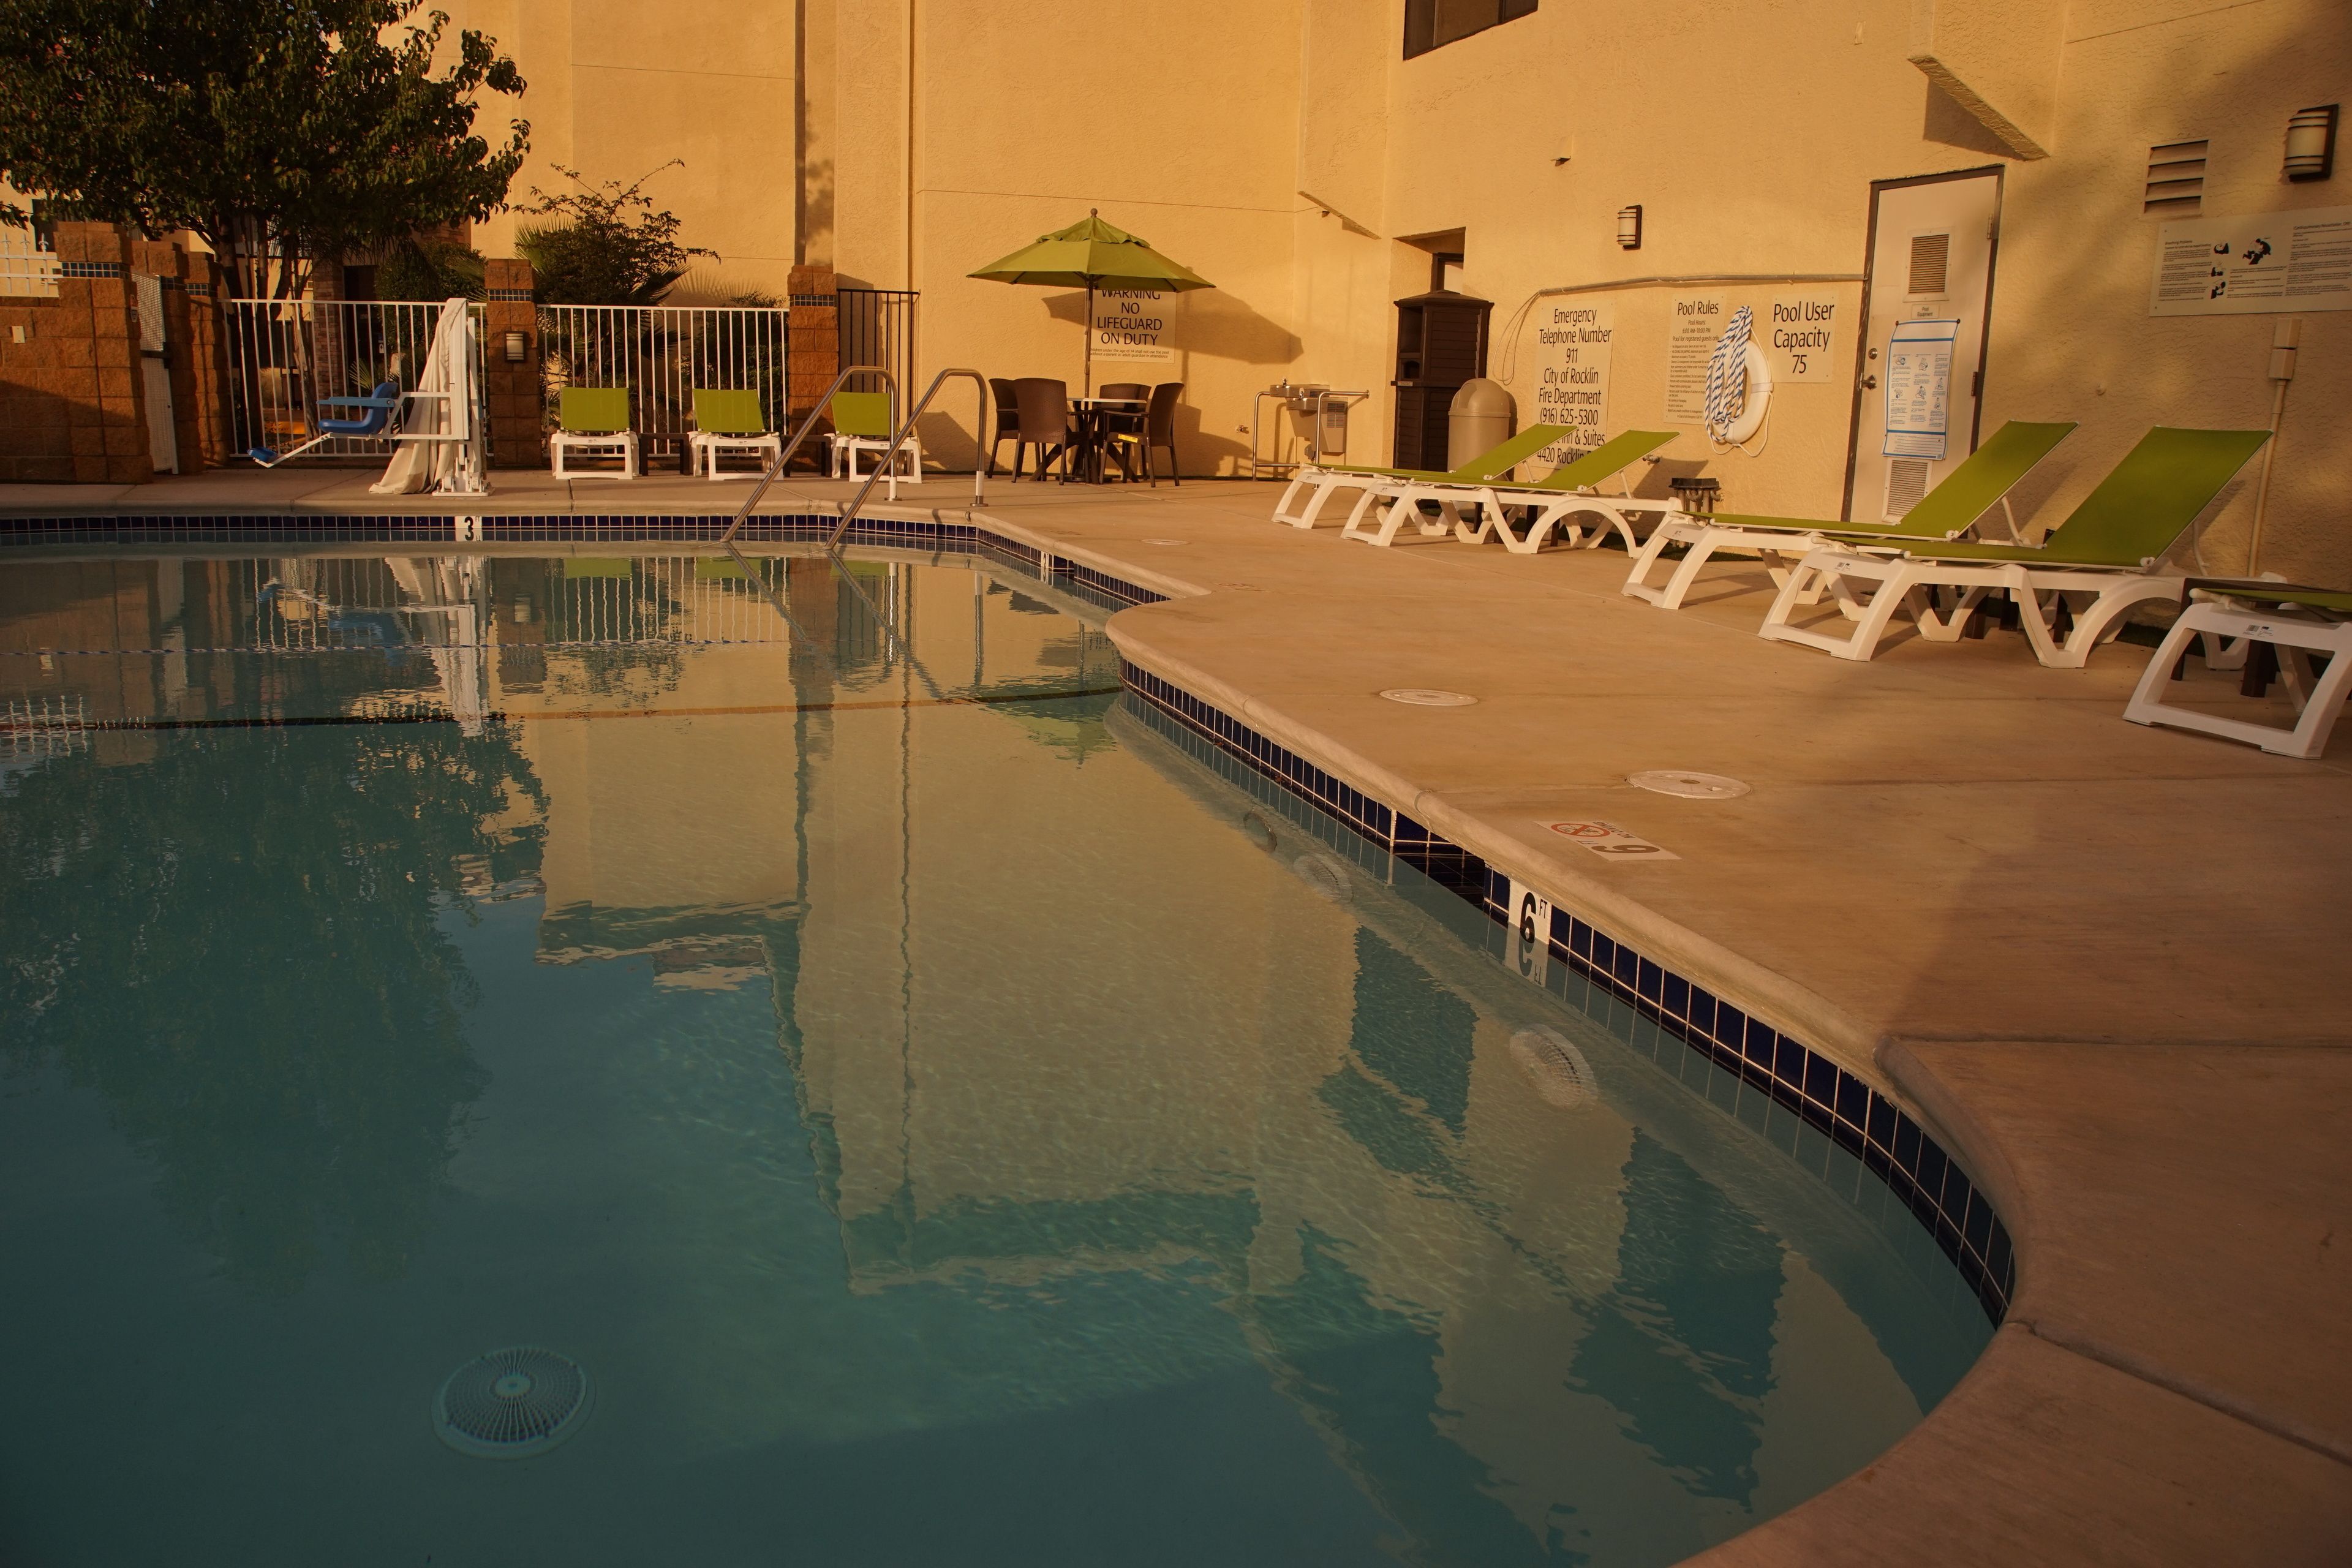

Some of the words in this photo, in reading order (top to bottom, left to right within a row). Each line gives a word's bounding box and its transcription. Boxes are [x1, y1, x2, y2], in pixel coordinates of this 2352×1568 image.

[1102, 289, 1160, 300] WARNING
[1121, 302, 1140, 314] NO
[1678, 301, 1695, 315] Pool
[1697, 300, 1719, 315] Rules
[1774, 301, 1801, 322] Pool
[1806, 301, 1834, 321] User
[1098, 317, 1162, 330] LIFEGUARD
[1554, 308, 1597, 326] Emergency
[1101, 332, 1120, 344] ON
[1124, 333, 1158, 345] DUTY
[1539, 327, 1577, 348] Telephone
[1578, 325, 1612, 343] Number
[1774, 326, 1830, 353] Capacity
[1566, 348, 1578, 363] 911
[1792, 355, 1807, 374] 75
[1544, 367, 1559, 387] City
[1561, 367, 1569, 383] of
[1570, 367, 1599, 384] Rocklin
[1539, 386, 1552, 403] Fire
[1554, 388, 1601, 407] Department
[1540, 407, 1558, 425] (916)
[1575, 429, 1580, 445] &
[1583, 429, 1605, 447] Suites
[1537, 447, 1555, 462] 4420
[1520, 892, 1536, 943] 6
[1539, 899, 1548, 919] FT
